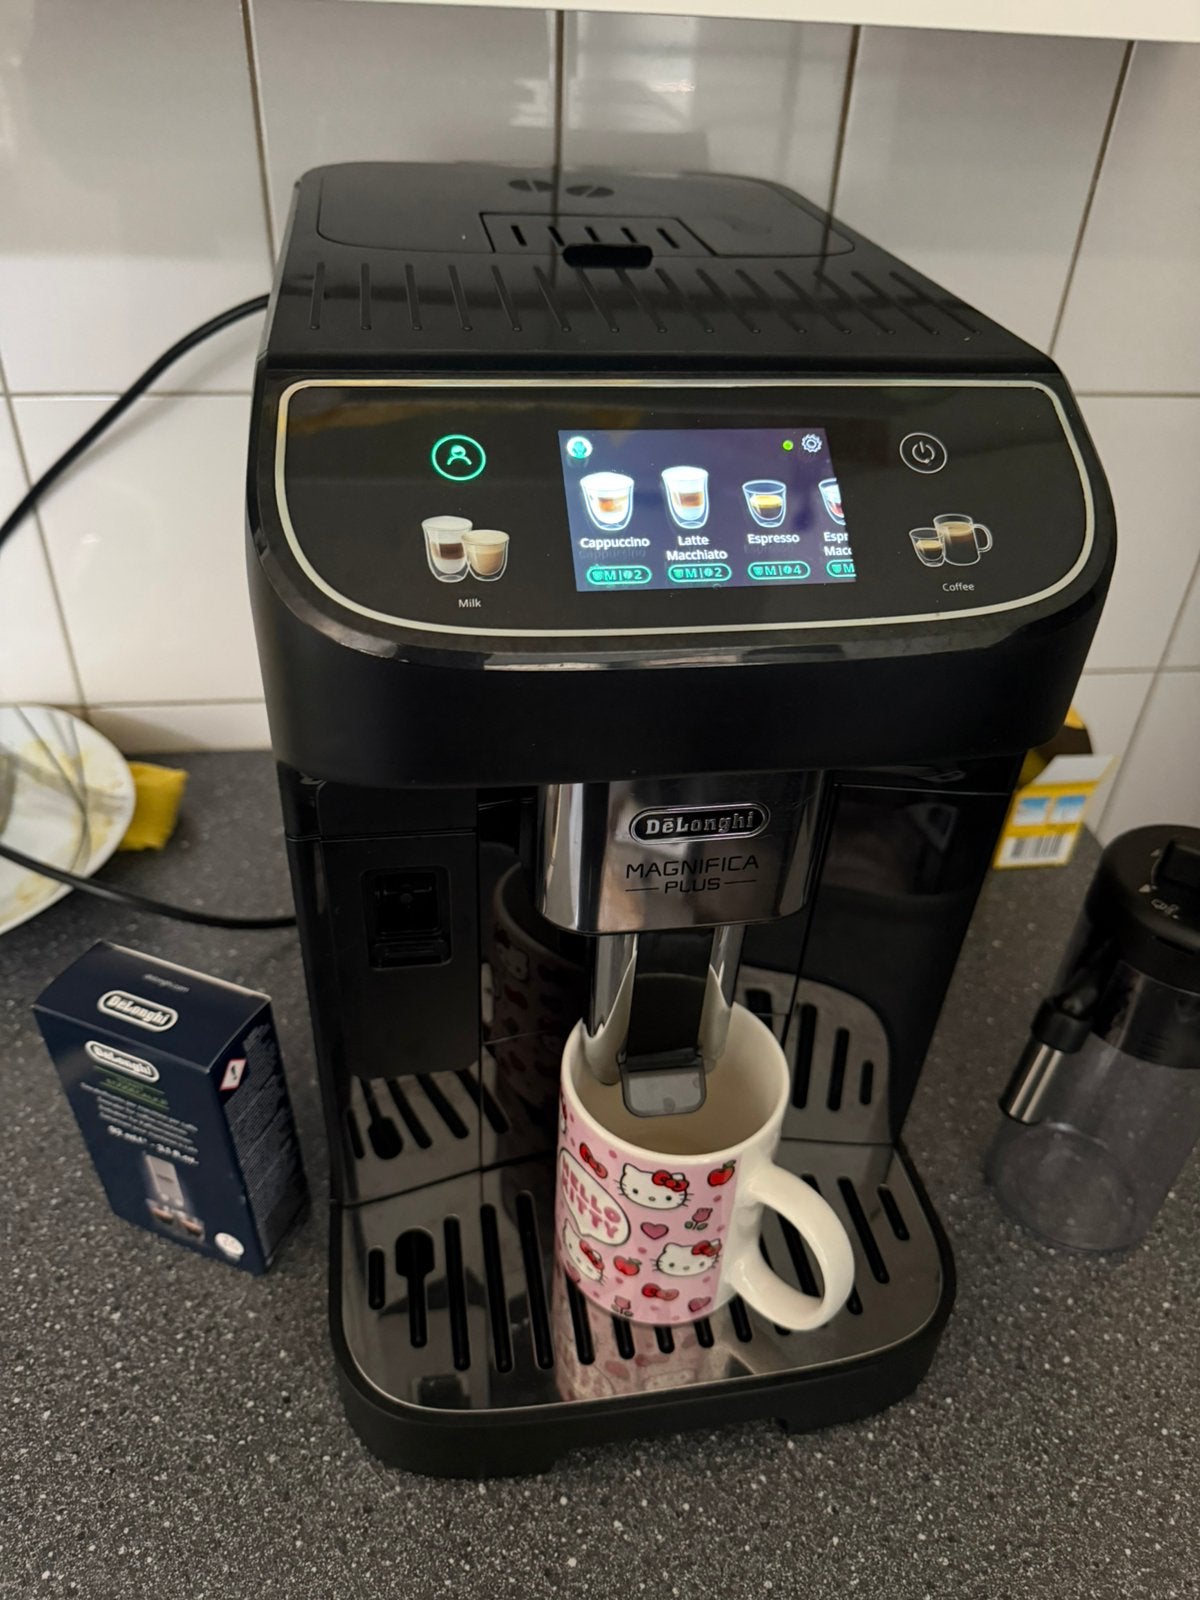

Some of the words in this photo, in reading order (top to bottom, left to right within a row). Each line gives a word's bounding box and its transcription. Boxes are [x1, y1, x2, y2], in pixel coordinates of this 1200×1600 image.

[579, 536, 651, 551] Cappuccino
[677, 535, 710, 547] Latte
[747, 533, 801, 546] Espresso
[666, 549, 728, 561] Macchiato
[942, 582, 975, 592] Coffee
[458, 598, 482, 608] Milk
[625, 854, 760, 879] MAGNIFICA
[664, 877, 721, 894] PLUS
